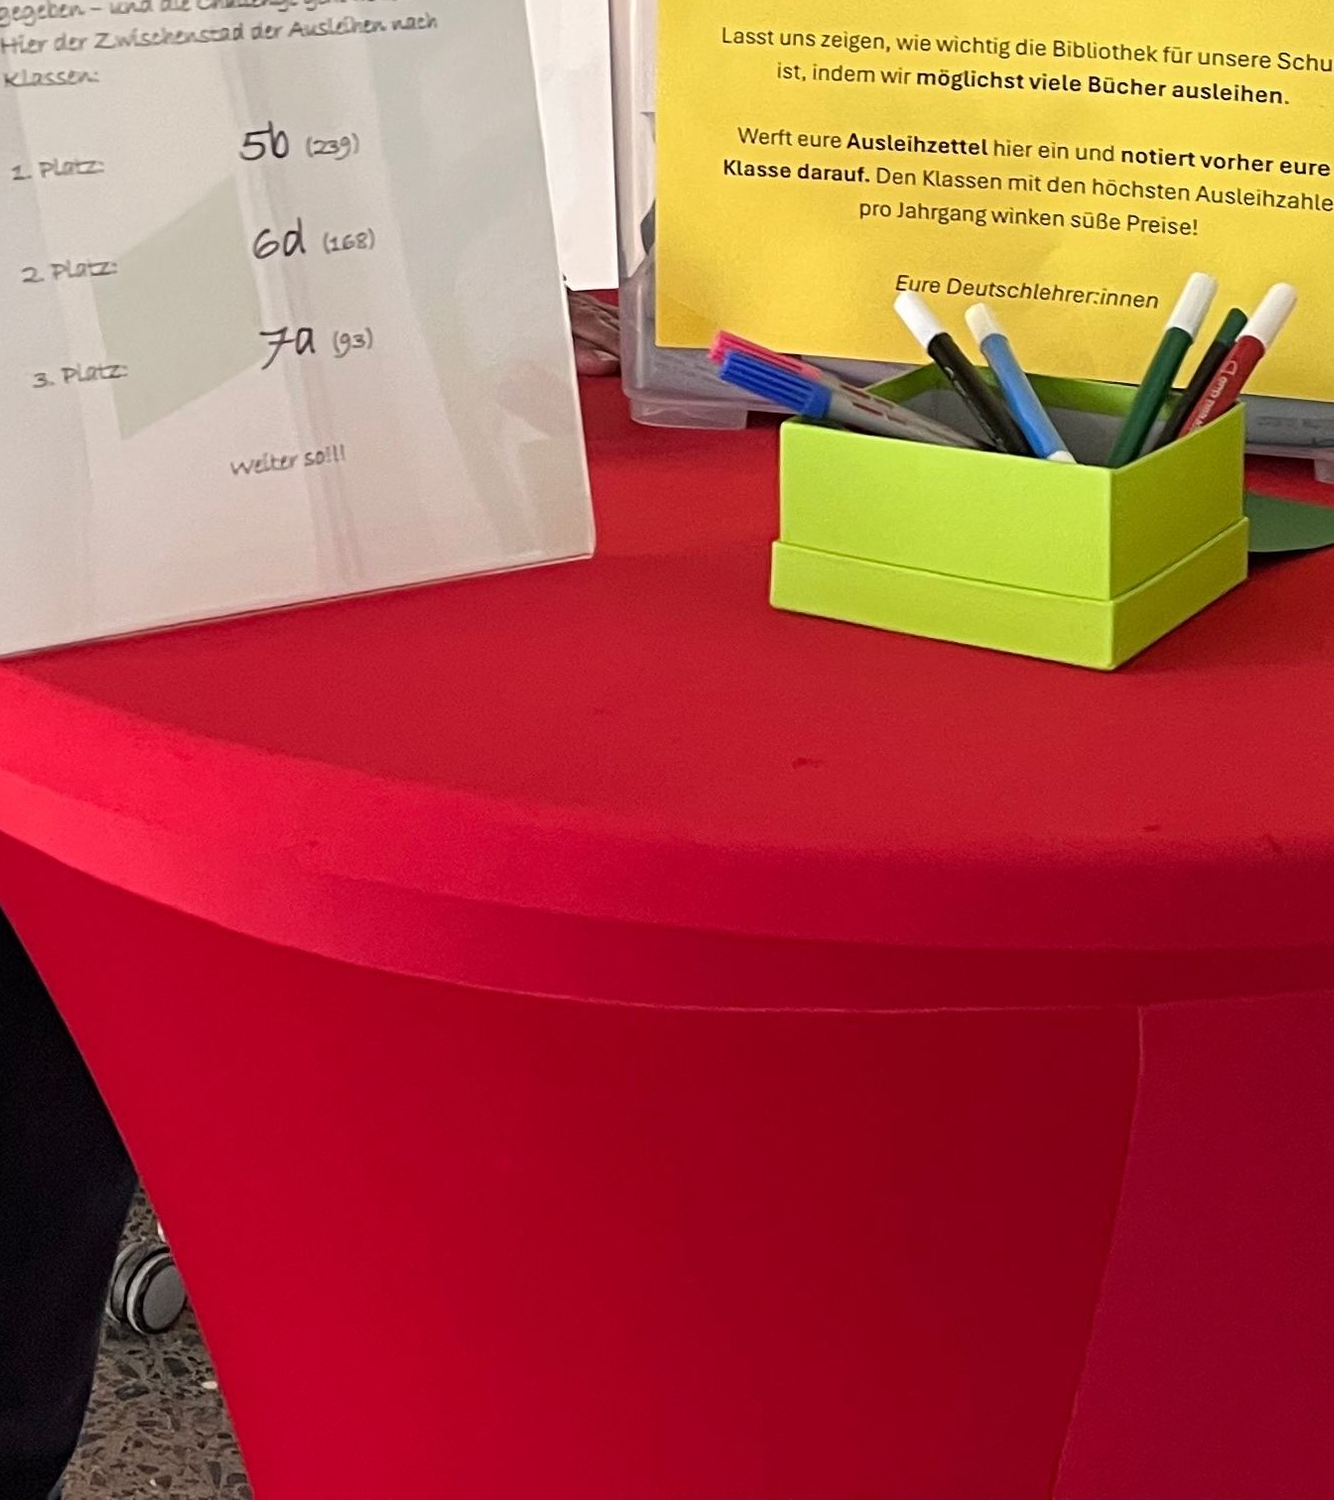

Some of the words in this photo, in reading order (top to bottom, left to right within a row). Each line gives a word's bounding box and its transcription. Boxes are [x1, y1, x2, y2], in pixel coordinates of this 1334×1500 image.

[0, 34, 49, 55] Hier
[53, 32, 88, 52] der
[250, 22, 284, 41] der
[287, 15, 388, 38] Ausleihen
[391, 11, 438, 32] nach
[722, 26, 775, 46] Lasst
[779, 32, 816, 47] uns
[820, 30, 891, 54] zeigen,
[896, 34, 932, 52] wie
[935, 35, 1011, 60] wichtig
[1015, 38, 1047, 57] die
[1052, 39, 1158, 63] Bibliothek
[1162, 46, 1193, 65] für
[1197, 51, 1272, 69] unsere
[777, 65, 806, 82] ist,
[812, 63, 876, 83] indem
[880, 70, 912, 85] wir
[916, 68, 1025, 92] möglichst
[1028, 72, 1082, 92] viele
[1088, 75, 1167, 97] Bücher
[1171, 82, 1290, 105] ausleihen.
[239, 120, 290, 162] 5b
[305, 132, 360, 161] (239)
[737, 127, 793, 147] Werft
[797, 133, 842, 149] eure
[846, 132, 989, 156] Ausleihzettel
[993, 139, 1033, 158] hier
[1037, 141, 1069, 160] ein
[1075, 145, 1115, 162] und
[1121, 147, 1196, 168] notiert
[1199, 153, 1274, 173] vorher
[1279, 160, 1331, 177] eure
[723, 158, 792, 179] Klasse
[797, 163, 871, 183] darauf.
[876, 166, 916, 186] Den
[922, 169, 1002, 190] Klassen
[1008, 176, 1042, 193] mit
[1046, 176, 1086, 195] den
[1092, 177, 1190, 202] höchsten
[252, 216, 307, 260] 6d
[322, 227, 376, 255] (168)
[859, 202, 892, 220] pro
[896, 201, 988, 227] Jahrgang
[990, 206, 1065, 227] winken
[1070, 211, 1121, 231] süße
[1126, 214, 1198, 236] Preise!
[894, 274, 941, 297] Eure
[946, 277, 1159, 309] Deutschlehrer:innen
[258, 326, 316, 371] 7a
[332, 326, 374, 358] (93)
